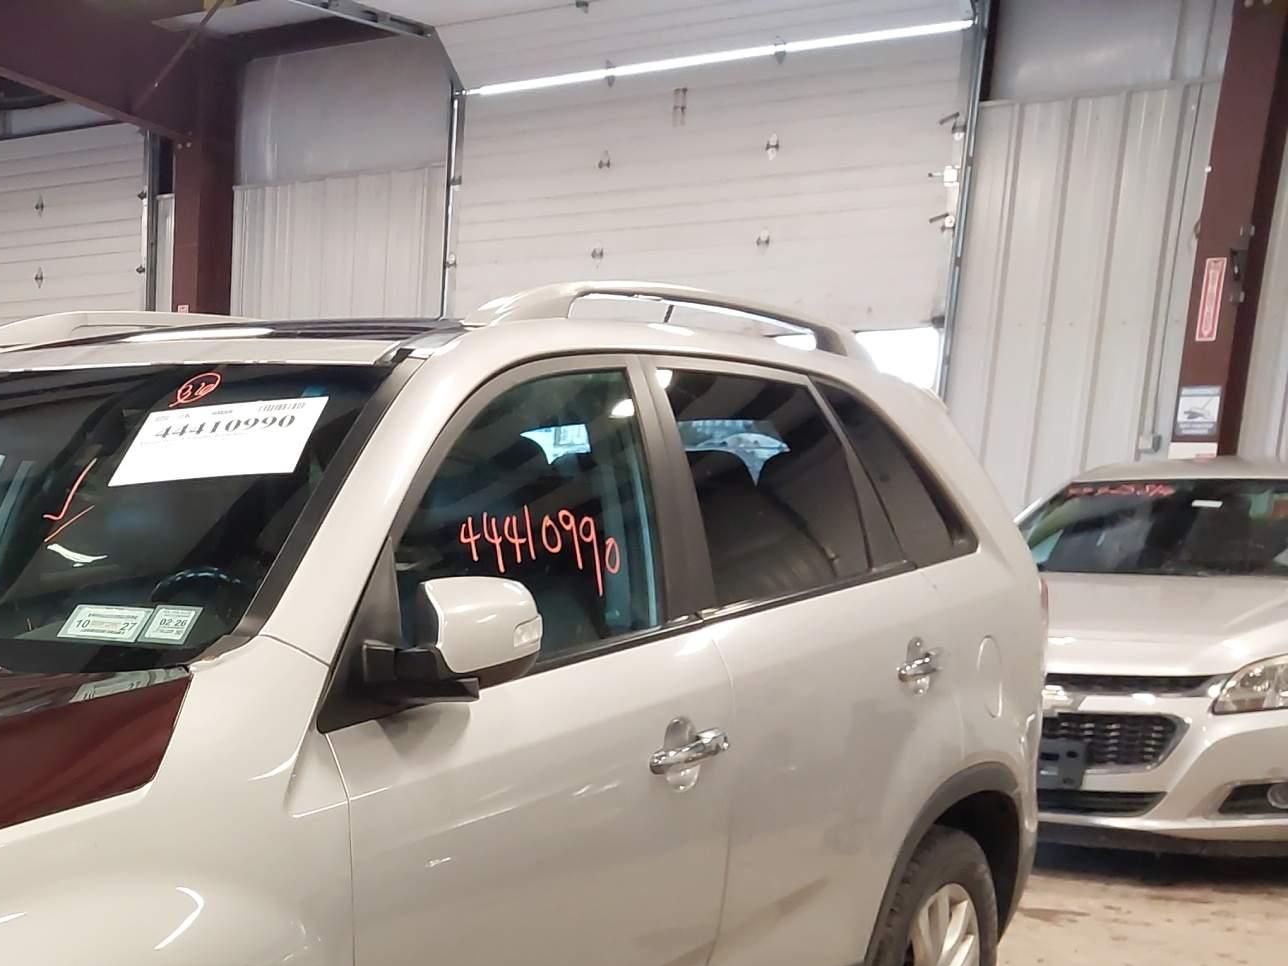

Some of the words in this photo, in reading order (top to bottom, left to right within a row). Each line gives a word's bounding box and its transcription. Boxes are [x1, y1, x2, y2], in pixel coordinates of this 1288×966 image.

[154, 414, 296, 439] 44410990
[460, 504, 621, 597] 44410990
[76, 619, 90, 628] 10
[119, 622, 138, 632] 27
[159, 618, 173, 627] 02
